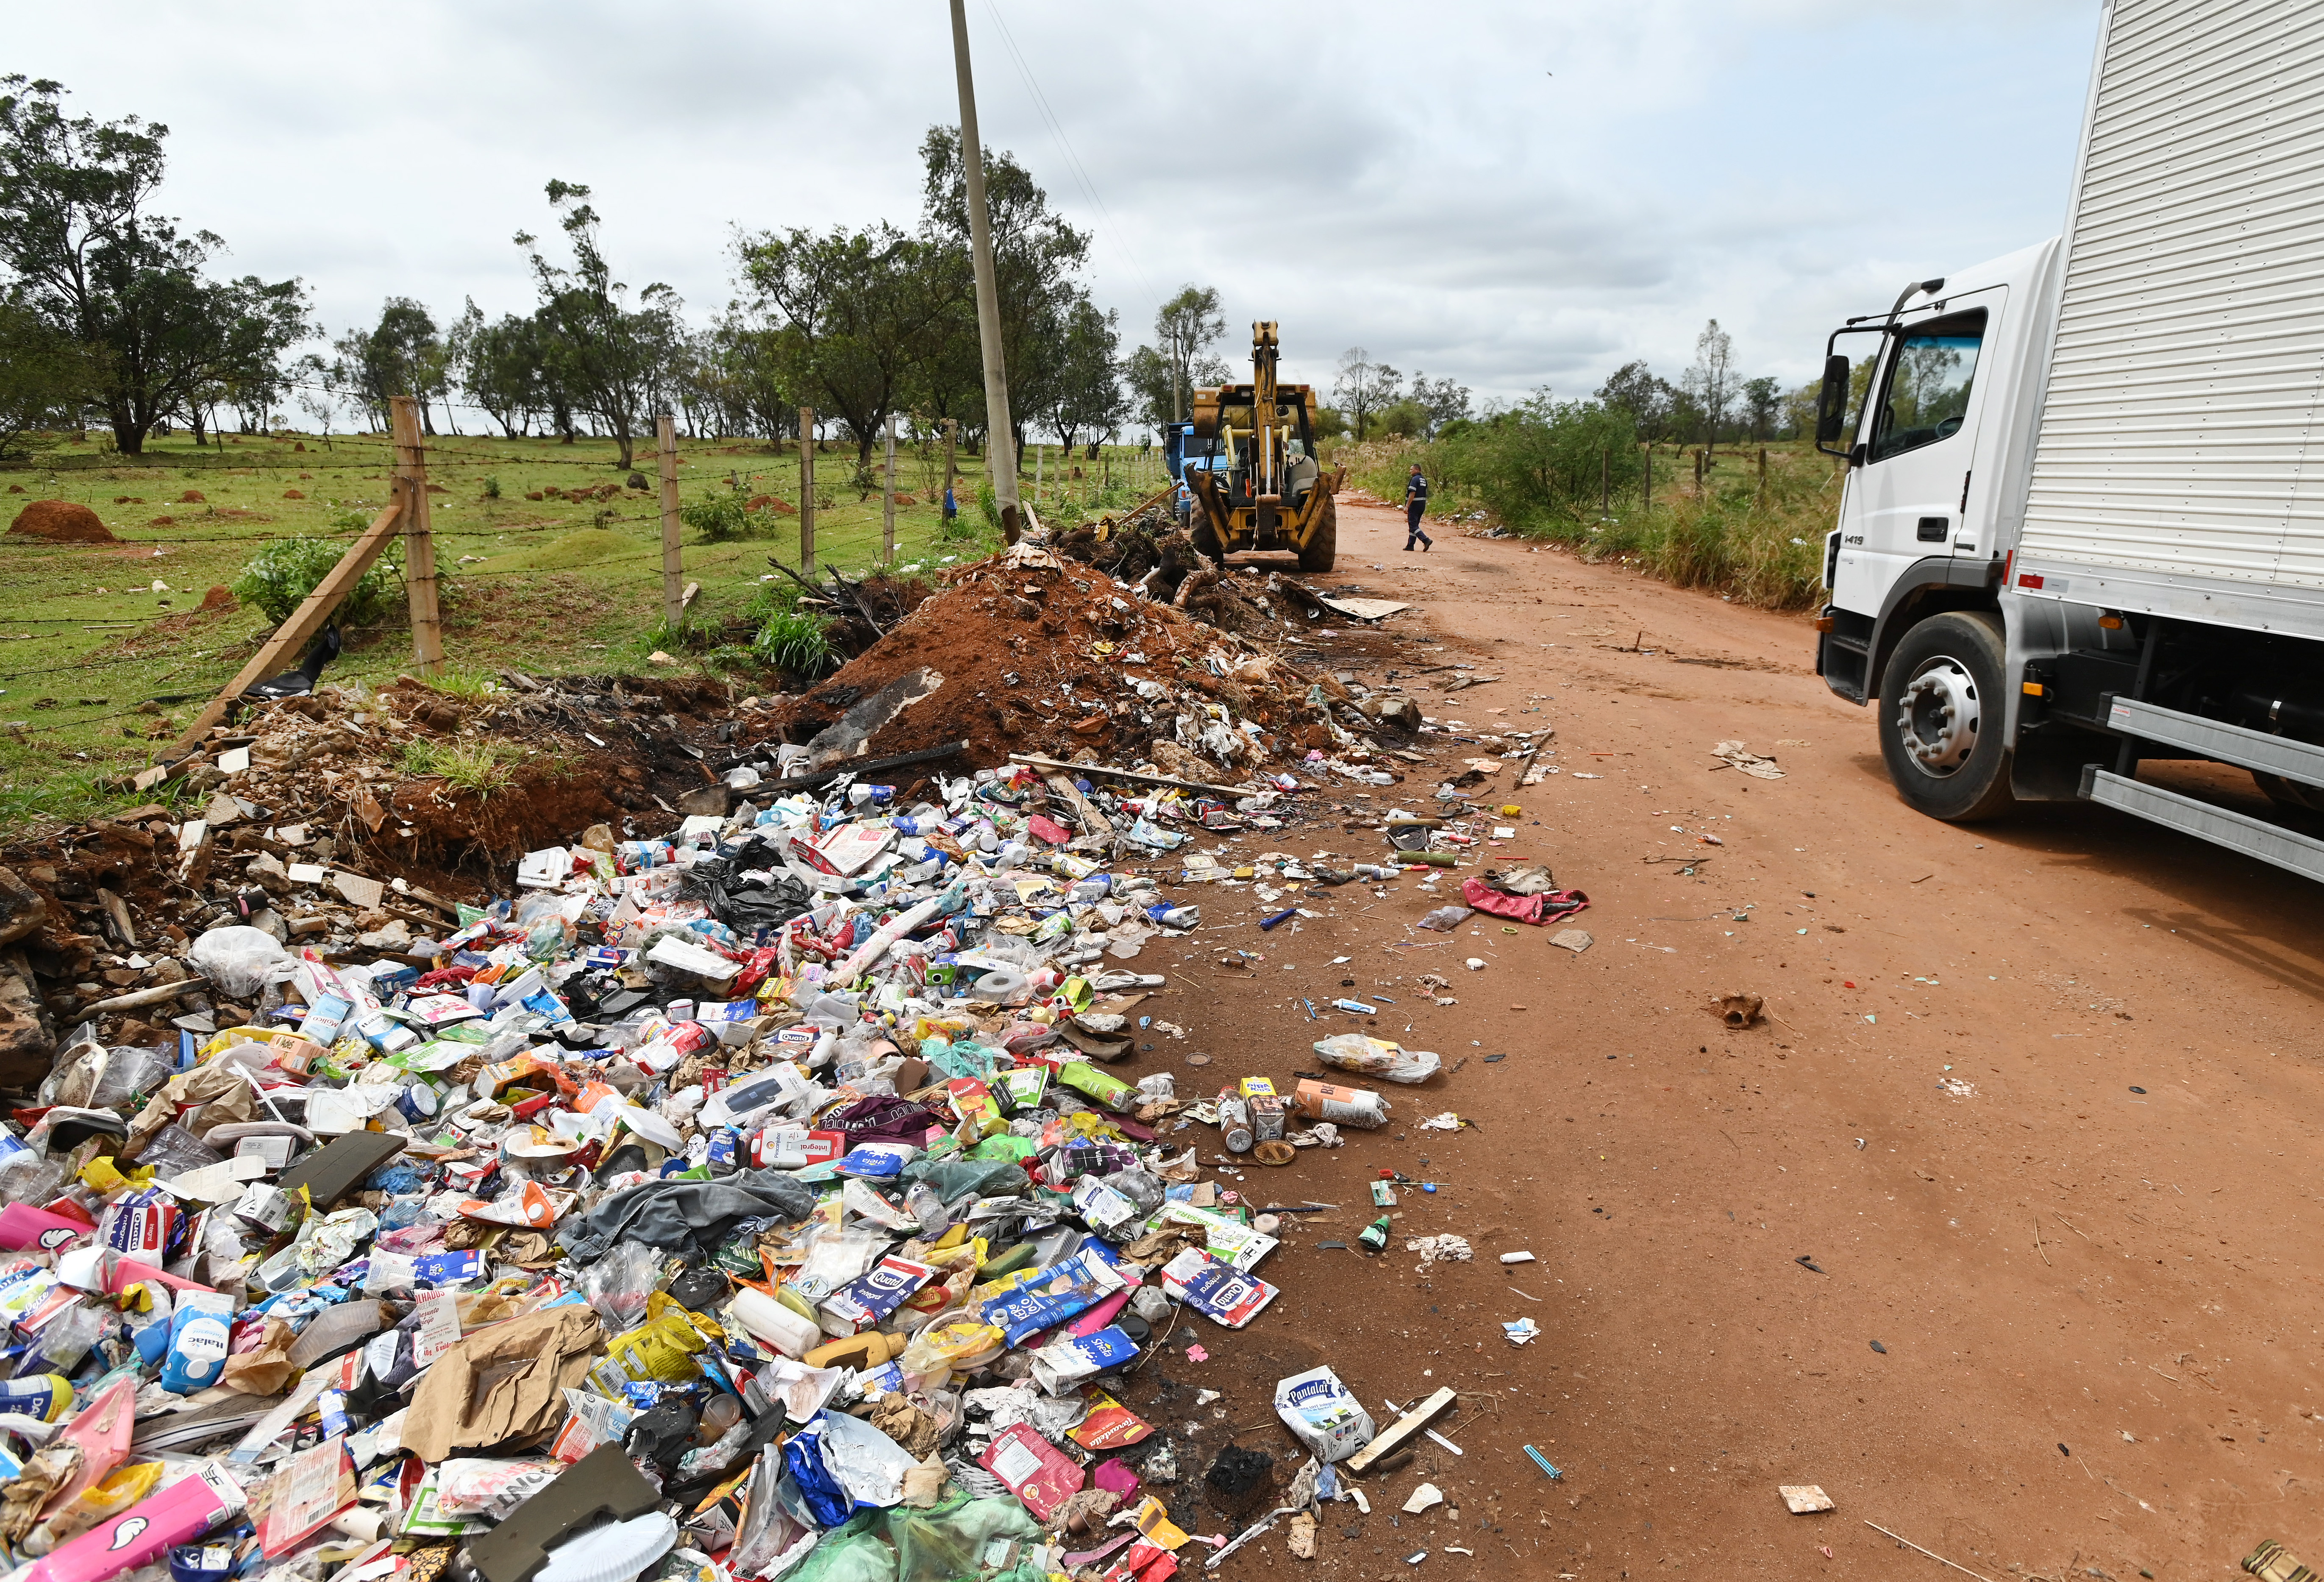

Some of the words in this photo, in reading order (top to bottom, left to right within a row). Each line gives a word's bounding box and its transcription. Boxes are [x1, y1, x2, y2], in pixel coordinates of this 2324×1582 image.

[1845, 536, 1863, 545] 1419
[313, 1015, 339, 1028] Molico
[783, 1033, 809, 1042] Quatá
[954, 1082, 977, 1097] MAGUARY
[800, 1144, 828, 1152] integral
[862, 1157, 887, 1166] Shefa
[1175, 1210, 1214, 1228] JUSSARA
[120, 1214, 129, 1249] Integral
[875, 1273, 901, 1287] Quatá
[857, 1289, 884, 1301] Integral
[914, 1292, 935, 1303] Sadia
[1218, 1285, 1243, 1306] Quatá
[25, 1290, 50, 1317] Leite
[188, 1339, 224, 1350] Italac
[1091, 1338, 1112, 1357] Shefa
[1290, 1383, 1329, 1404] Pantalat
[1089, 1417, 1136, 1447] Tarantella
